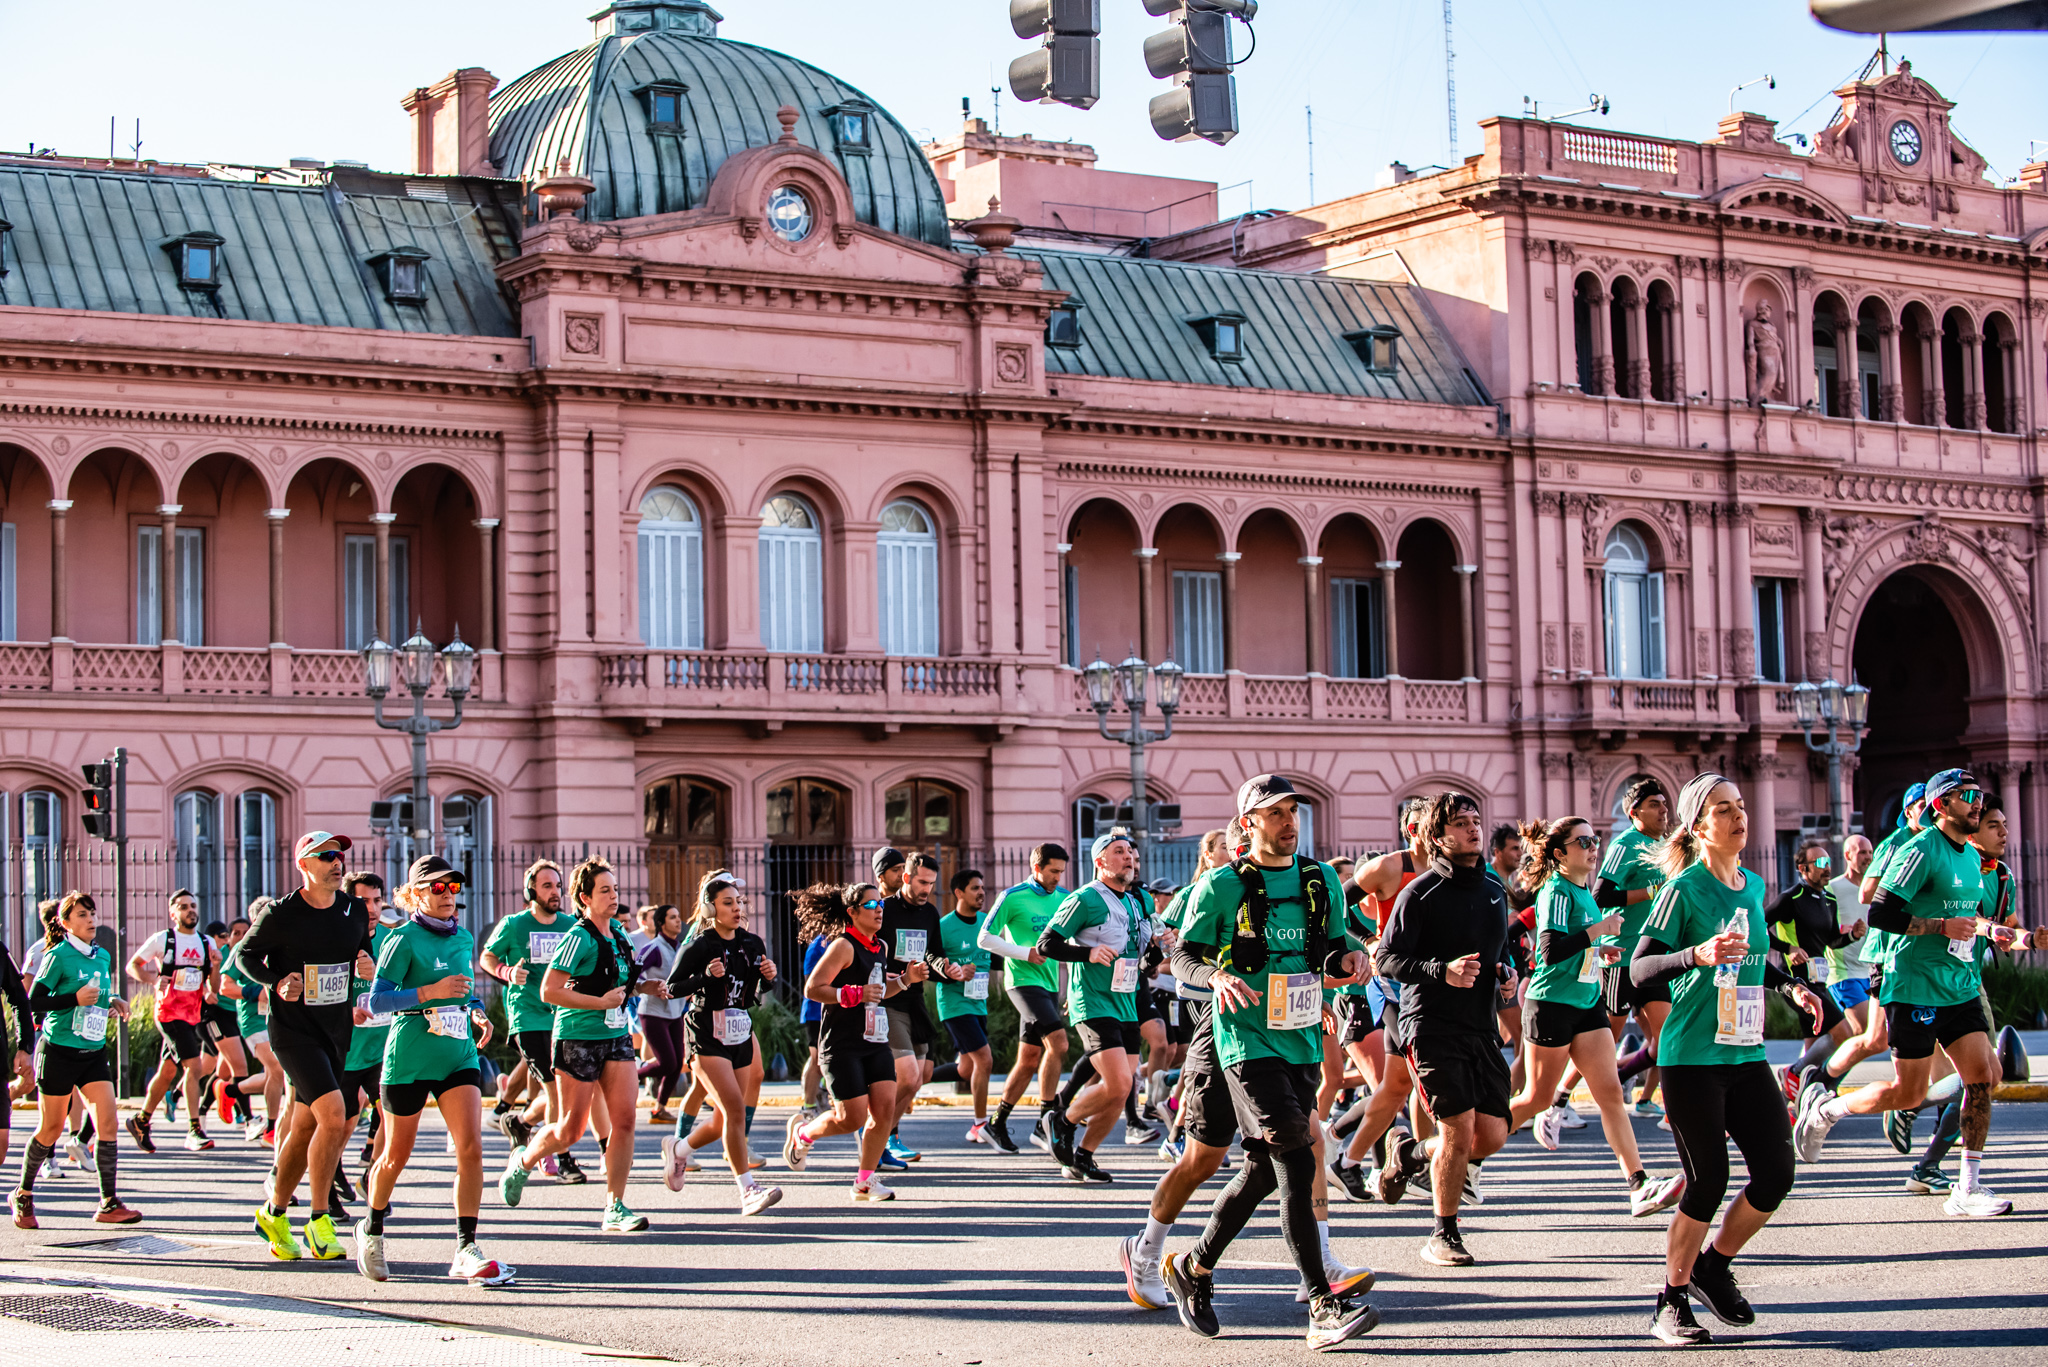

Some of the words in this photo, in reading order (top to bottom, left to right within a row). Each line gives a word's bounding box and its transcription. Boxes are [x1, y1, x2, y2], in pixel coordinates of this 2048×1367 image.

[533, 934, 538, 946] F
[900, 932, 904, 943] E
[1276, 928, 1306, 940] GOT
[907, 939, 925, 952] 6100
[309, 969, 315, 982] G
[319, 974, 349, 993] 14857
[1274, 980, 1283, 998] G
[1289, 985, 1322, 1013] 14871
[1724, 992, 1733, 1012] G
